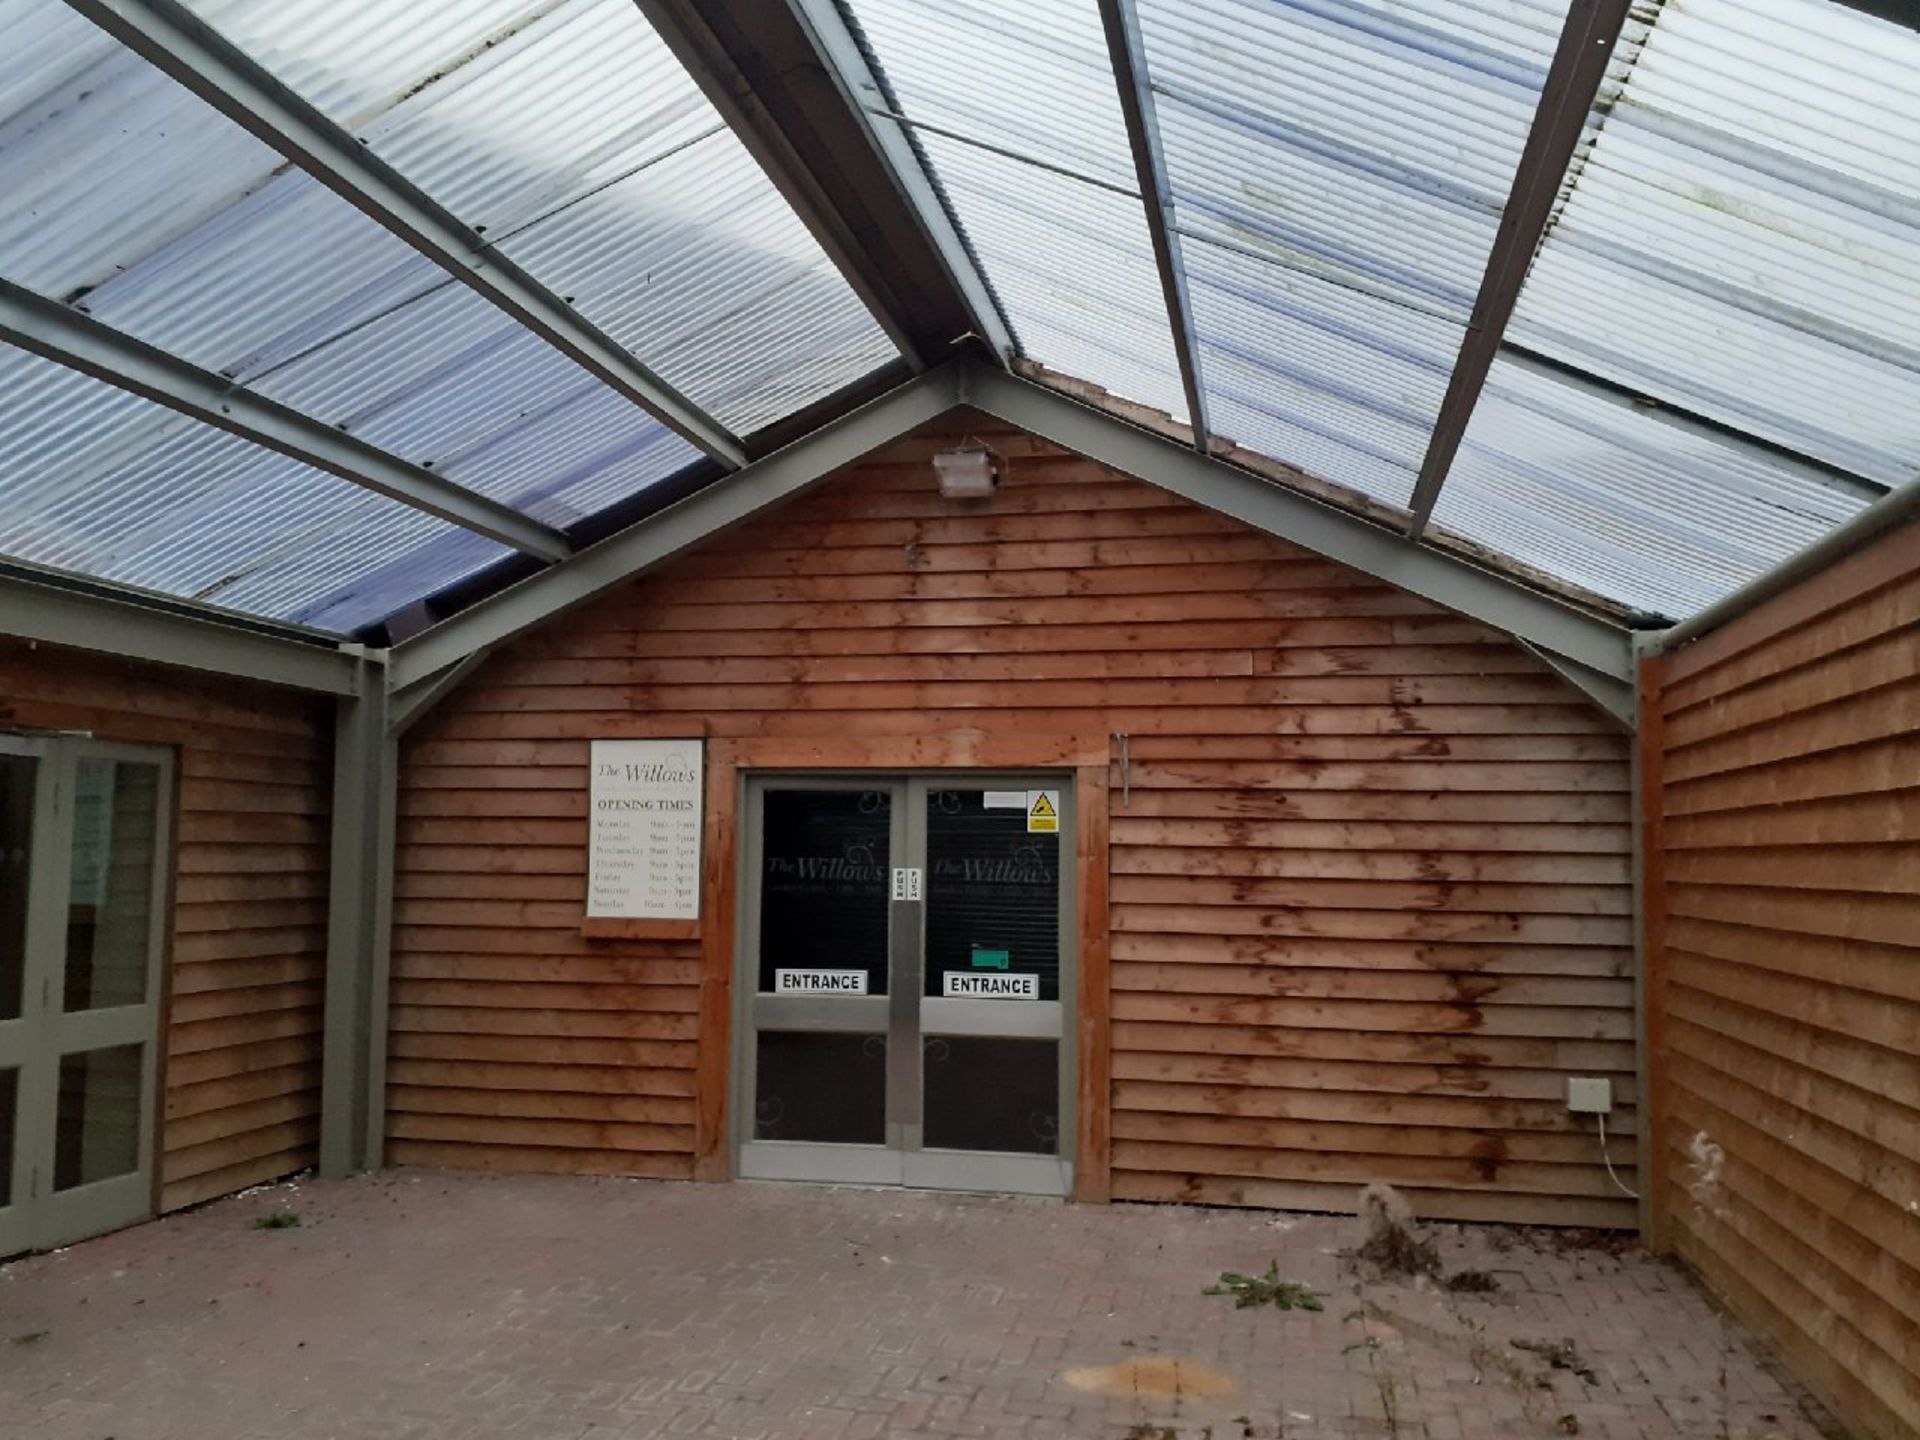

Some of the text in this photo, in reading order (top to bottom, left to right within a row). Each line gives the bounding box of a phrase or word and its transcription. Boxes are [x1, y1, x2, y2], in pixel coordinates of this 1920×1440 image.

[599, 764, 696, 783] The Willows
[597, 799, 694, 811] OPENING TIMES
[767, 856, 885, 881] The Willows
[962, 857, 1051, 883] Willows
[782, 973, 859, 989] ENTRANCE
[951, 977, 1032, 993] ENTRANCE
